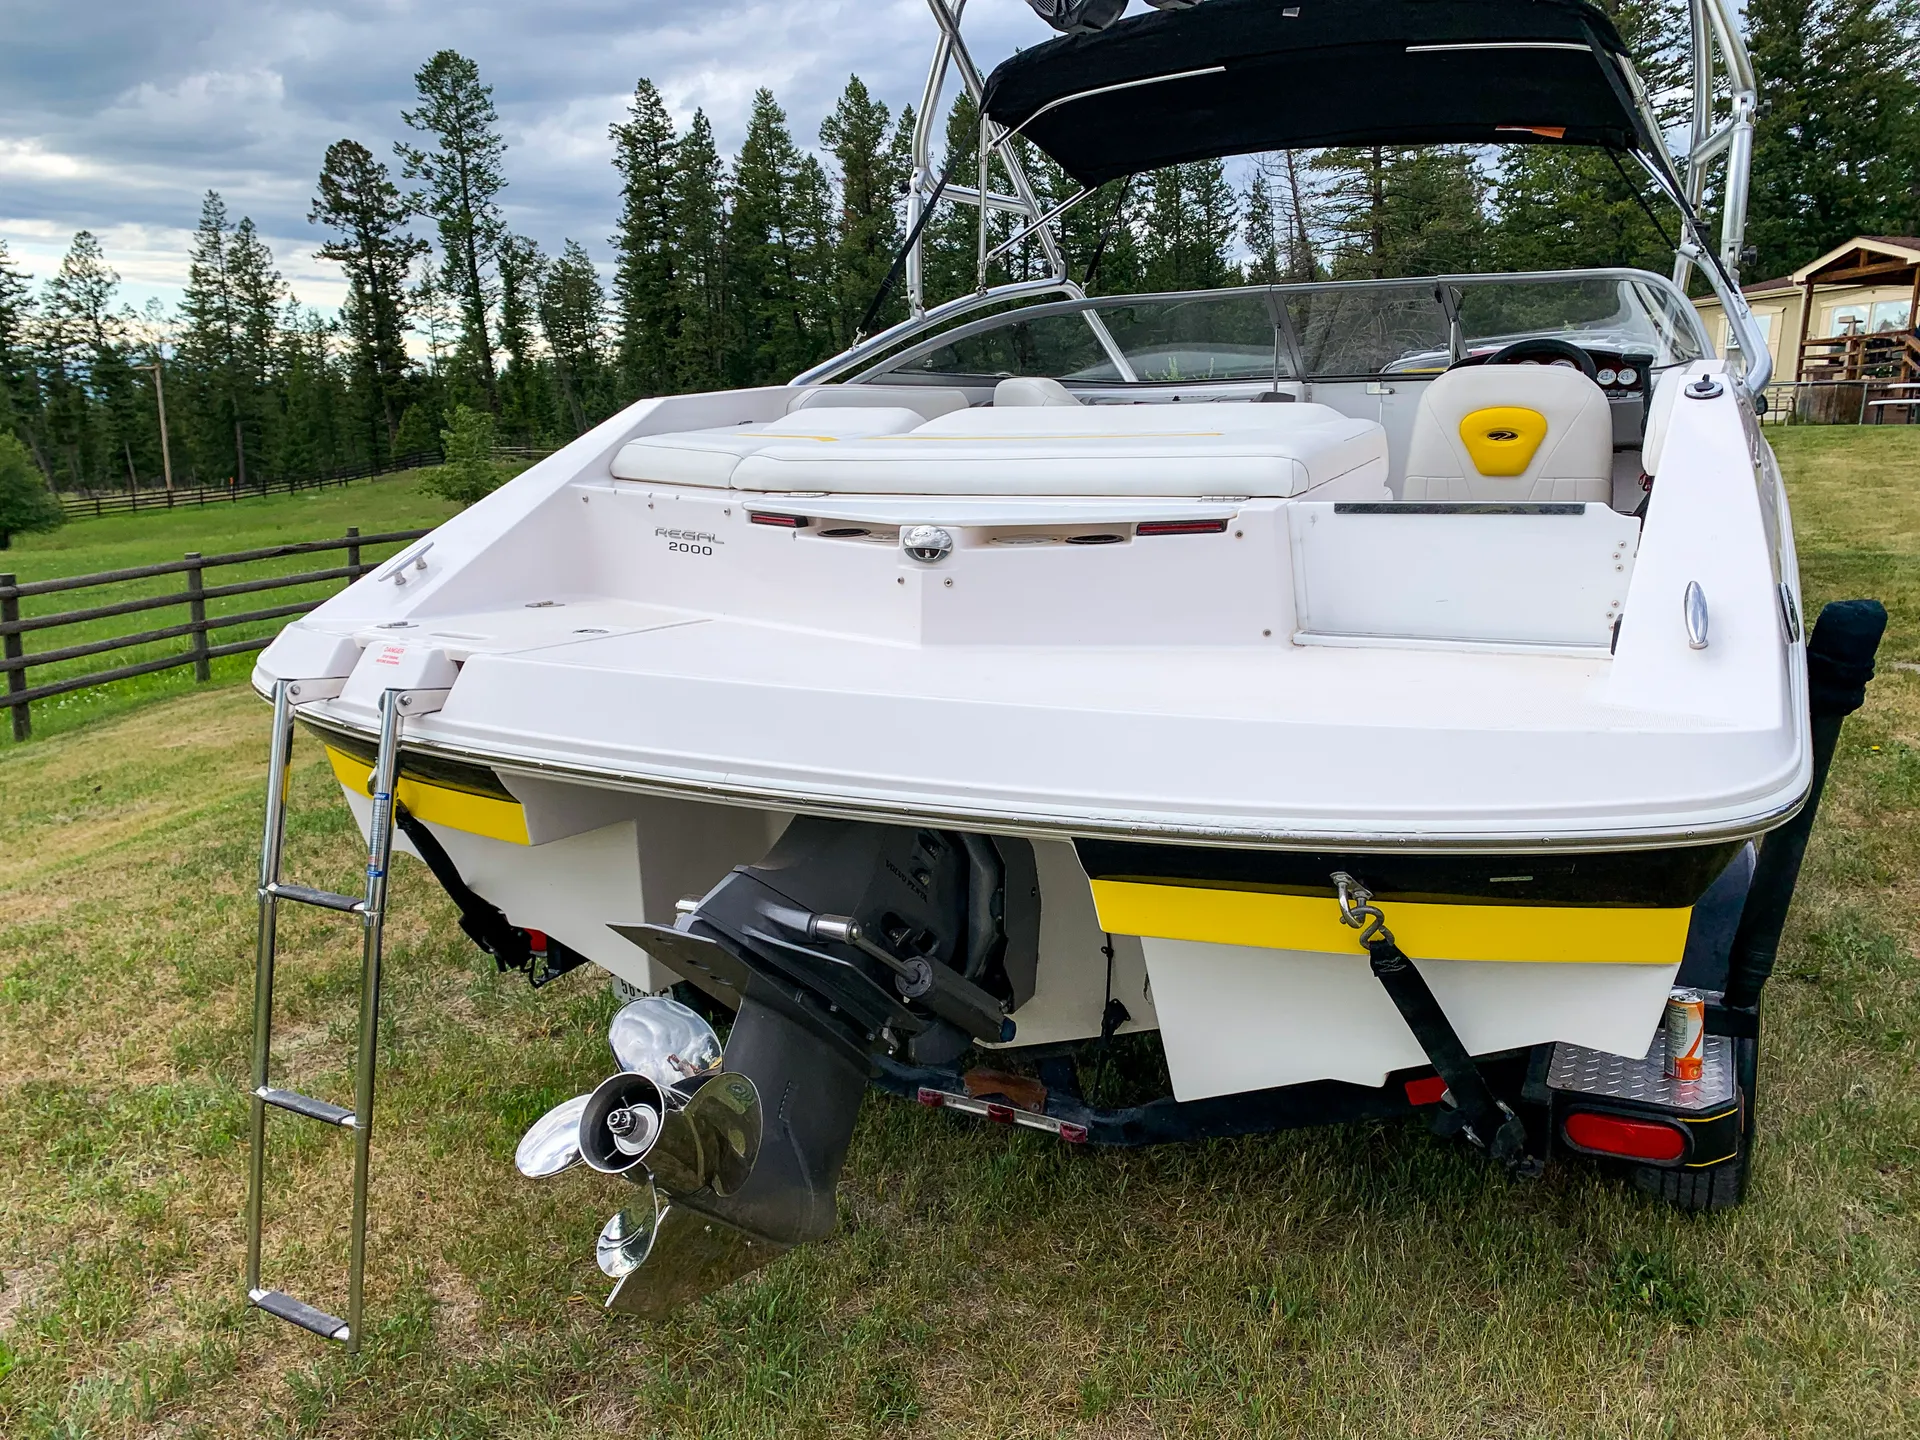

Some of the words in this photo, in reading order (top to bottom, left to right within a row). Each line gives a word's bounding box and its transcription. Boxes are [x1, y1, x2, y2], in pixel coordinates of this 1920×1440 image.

[655, 527, 724, 544] REGAL
[669, 541, 712, 556] 2000
[886, 859, 907, 882] VOLVO
[907, 880, 928, 904] PENTA
